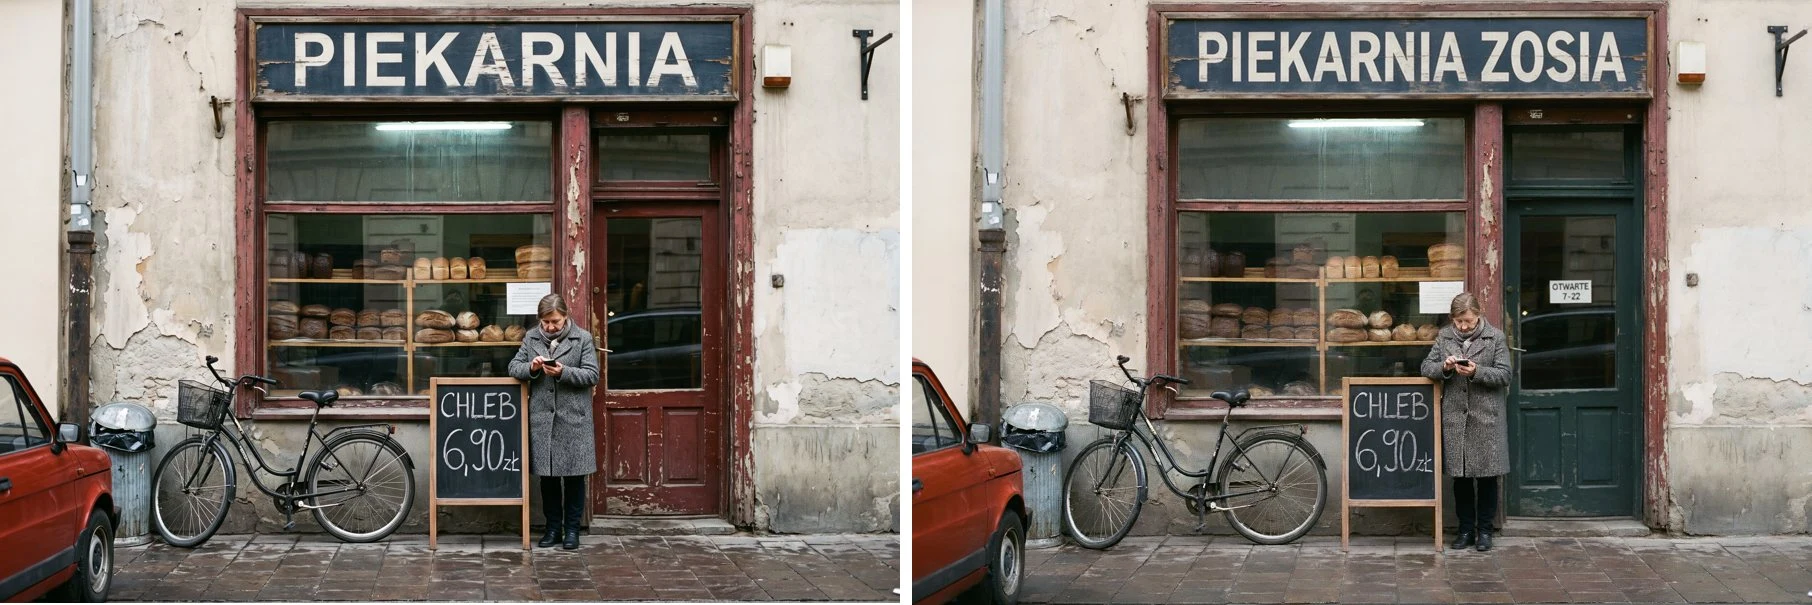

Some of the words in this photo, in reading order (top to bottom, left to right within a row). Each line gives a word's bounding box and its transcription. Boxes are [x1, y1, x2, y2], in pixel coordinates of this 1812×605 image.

[295, 32, 698, 87] PIEKARNIA
[1199, 31, 1468, 83] PIEKARNIA
[1481, 30, 1627, 83] ZOSIA
[1552, 283, 1589, 291] OTWARTE
[441, 392, 517, 420] CHLEB
[1353, 392, 1429, 420] CHLEB
